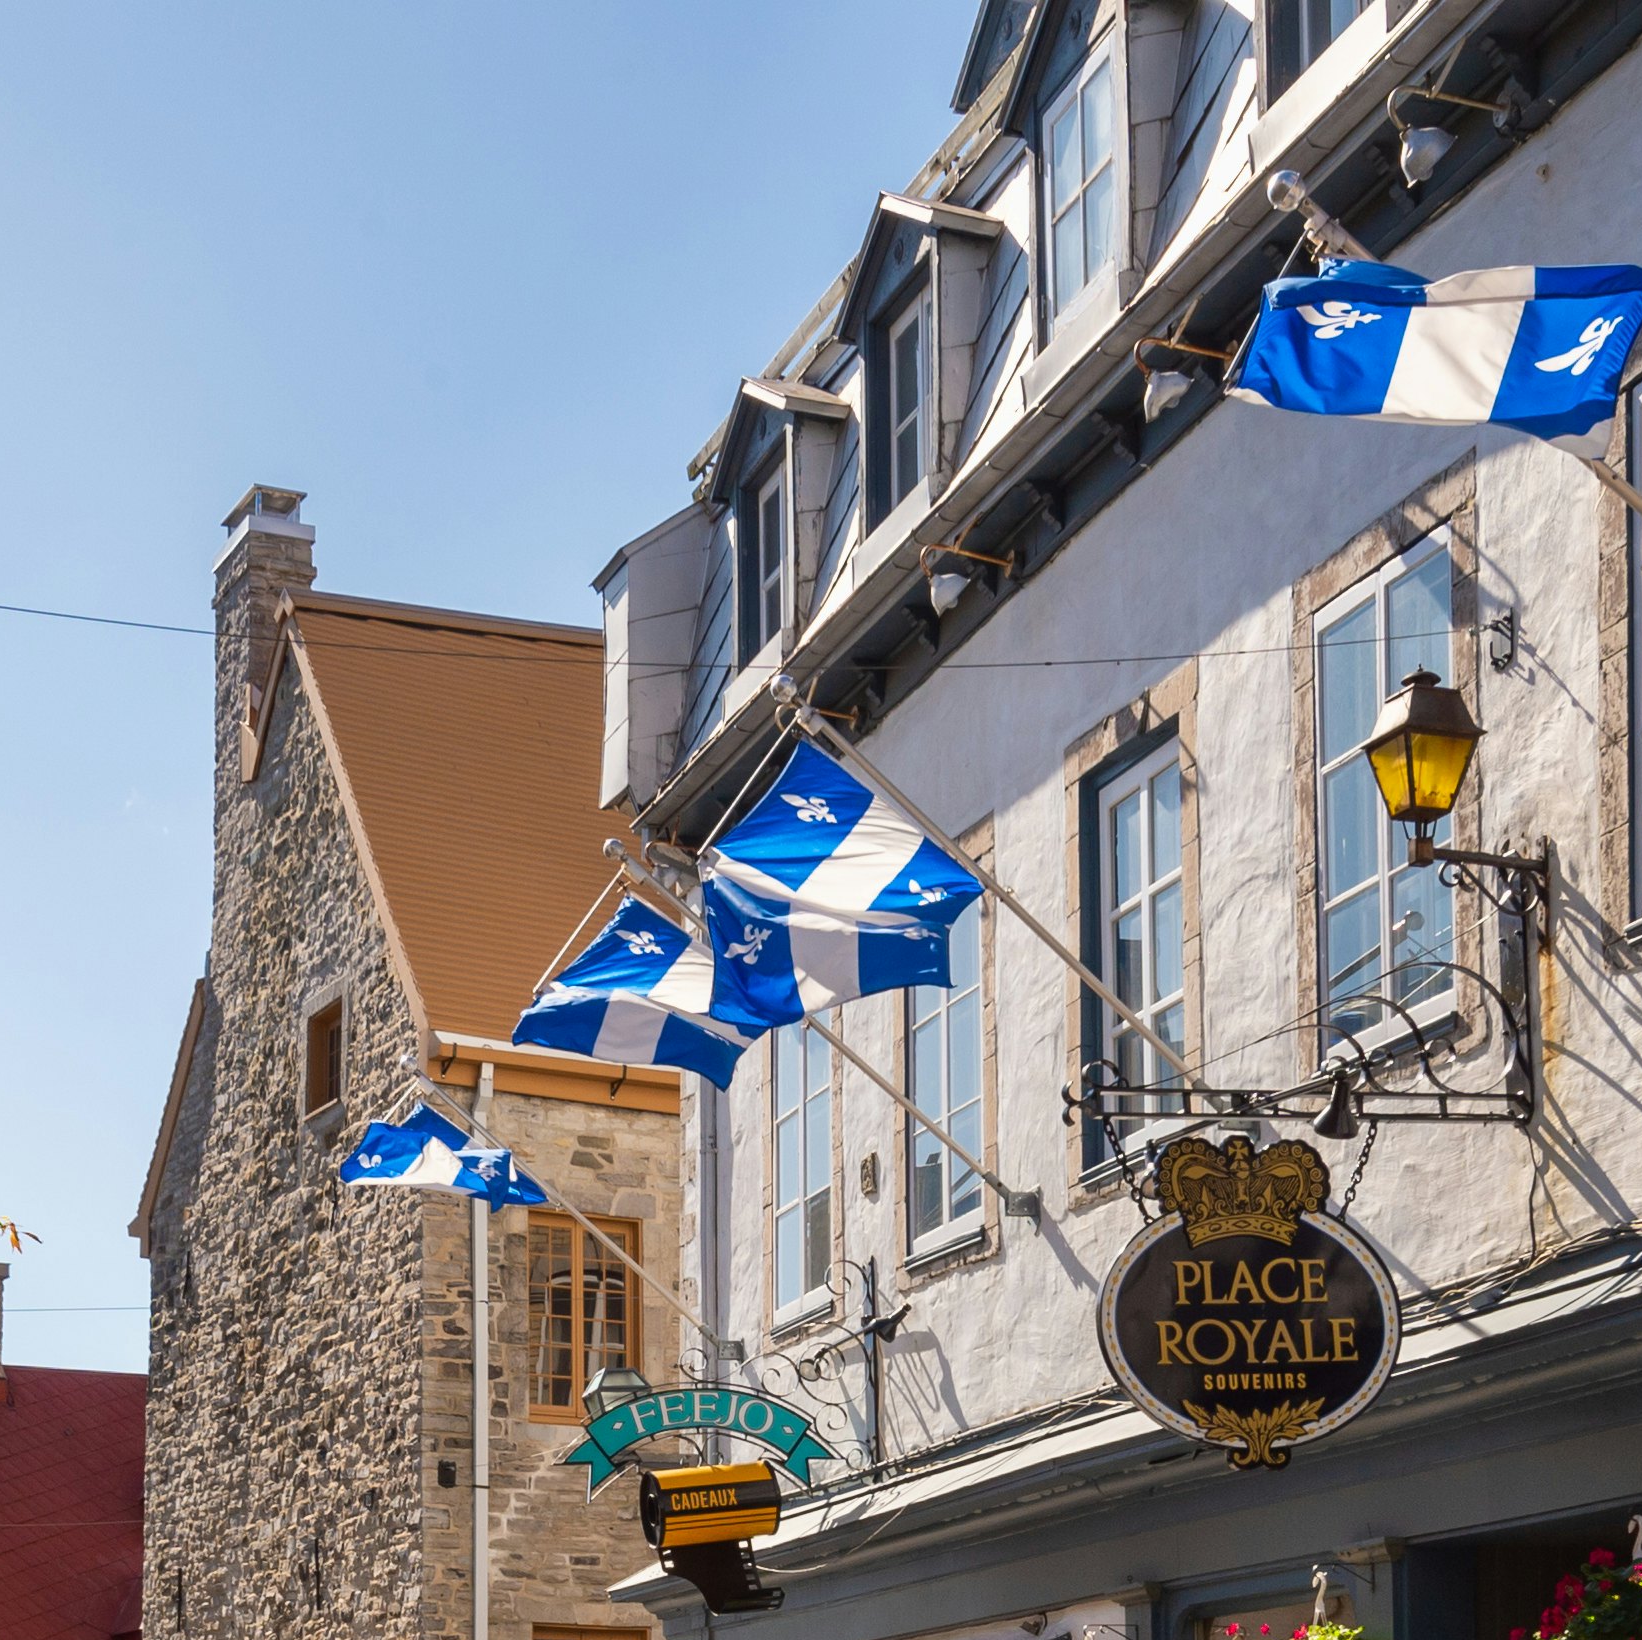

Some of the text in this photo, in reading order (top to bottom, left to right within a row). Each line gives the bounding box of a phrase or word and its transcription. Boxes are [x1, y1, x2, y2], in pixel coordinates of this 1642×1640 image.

[1172, 1257, 1329, 1306] PLACE
[1155, 1317, 1359, 1366] ROYALE
[1203, 1372, 1307, 1391] SOUVENIRS
[628, 1391, 774, 1435] FEEJO
[670, 1488, 739, 1511] CADEAUX
